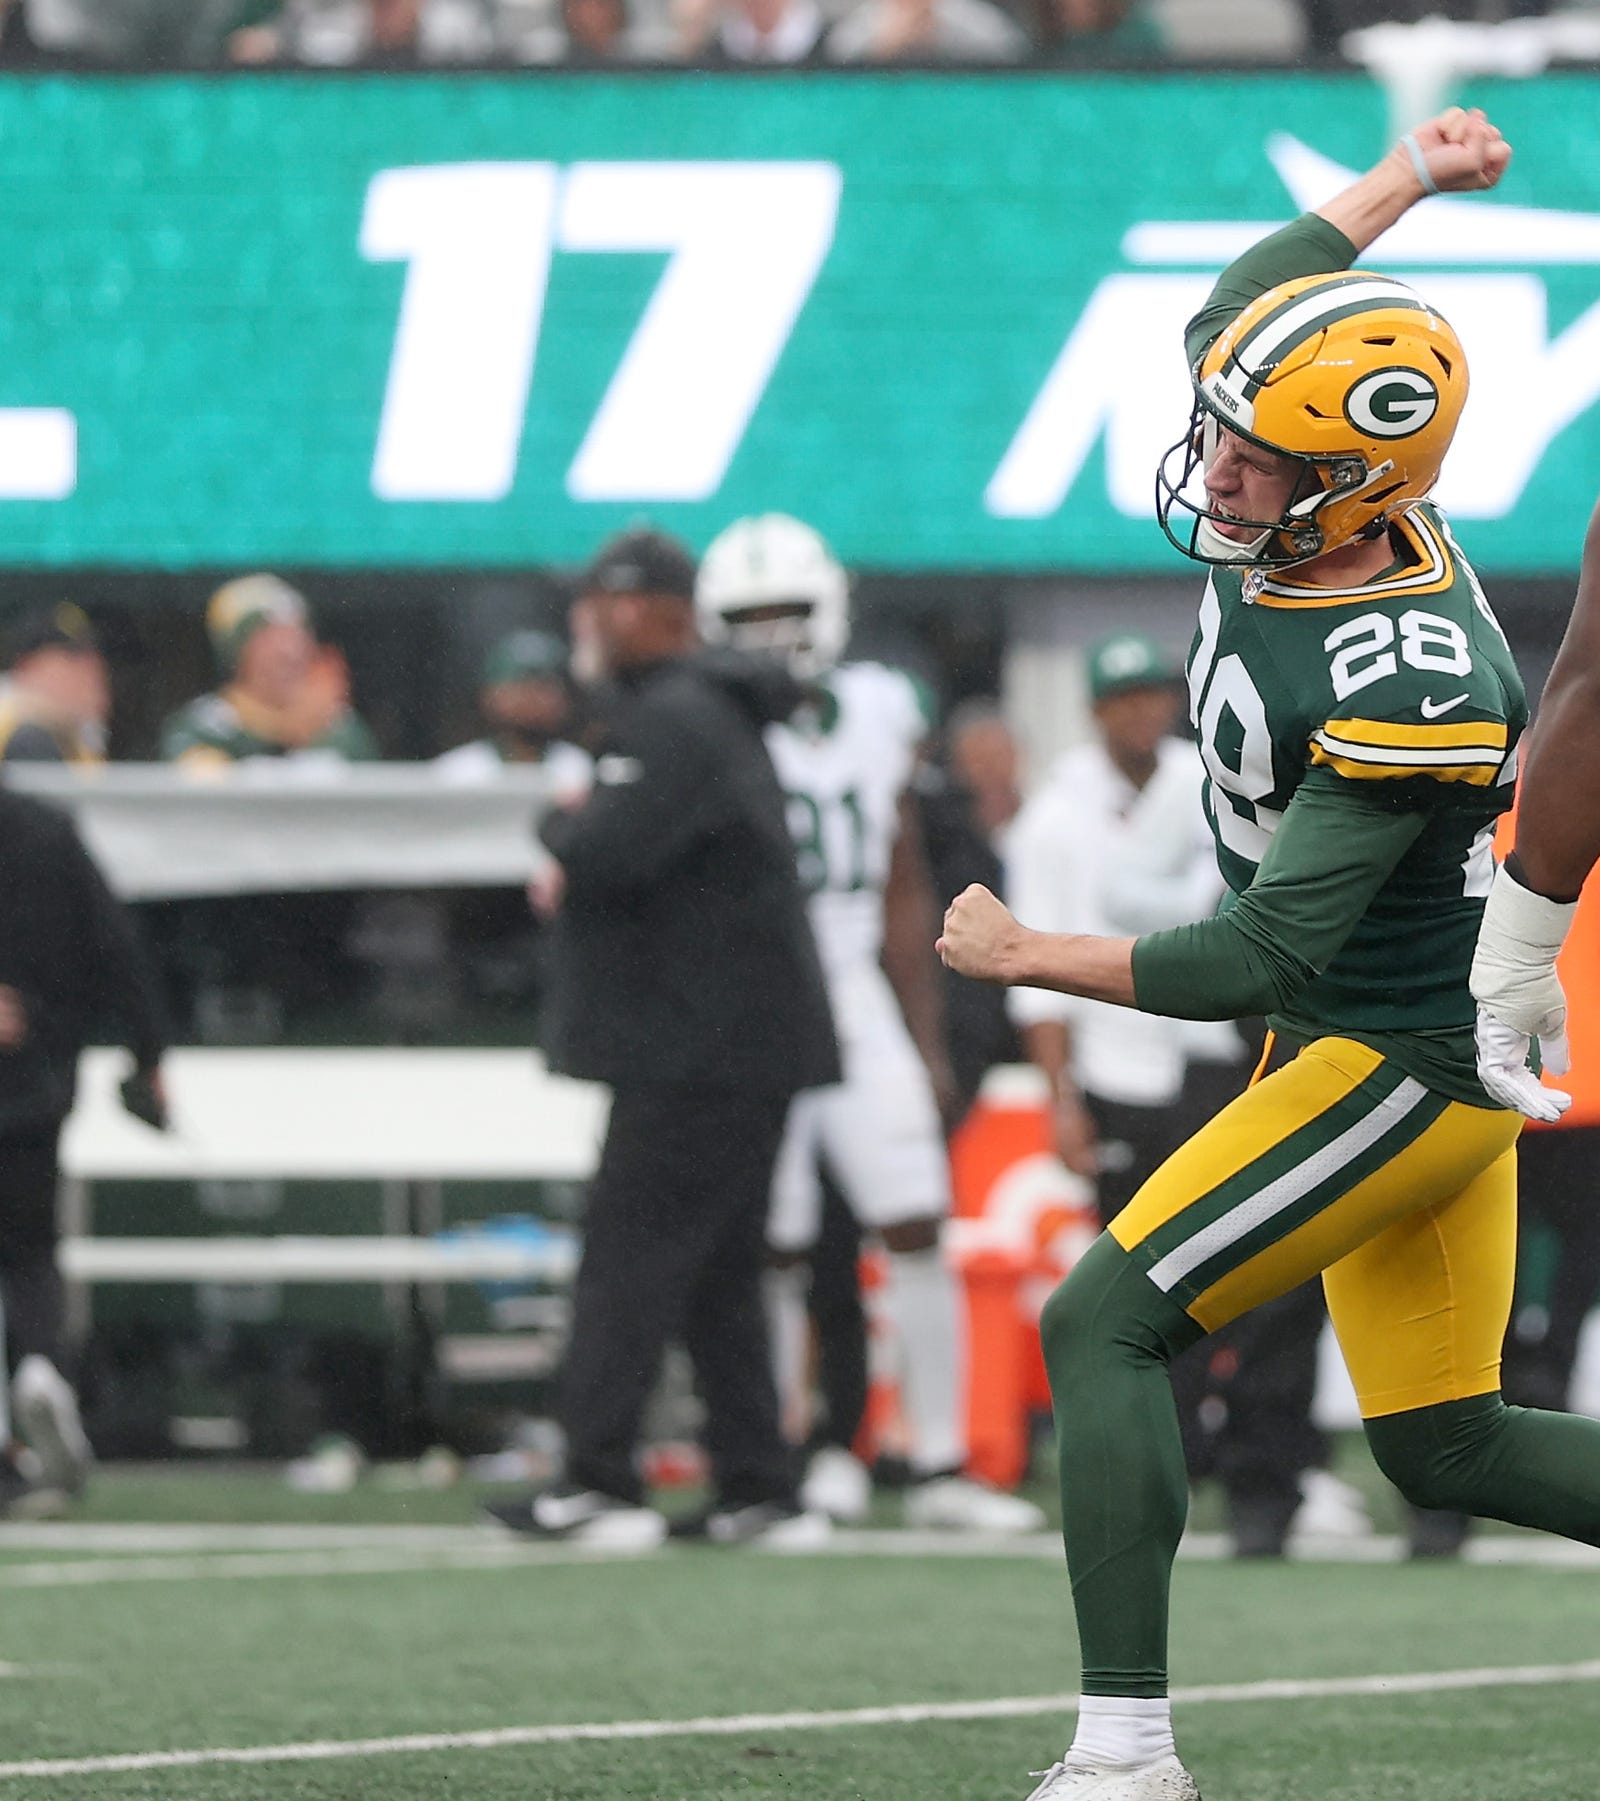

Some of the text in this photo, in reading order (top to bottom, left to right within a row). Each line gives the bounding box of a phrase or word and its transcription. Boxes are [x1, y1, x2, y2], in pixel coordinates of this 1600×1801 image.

[359, 160, 843, 502] 17
[1212, 382, 1240, 414] PACKERS
[1347, 370, 1436, 436] G
[1324, 609, 1473, 702] 28
